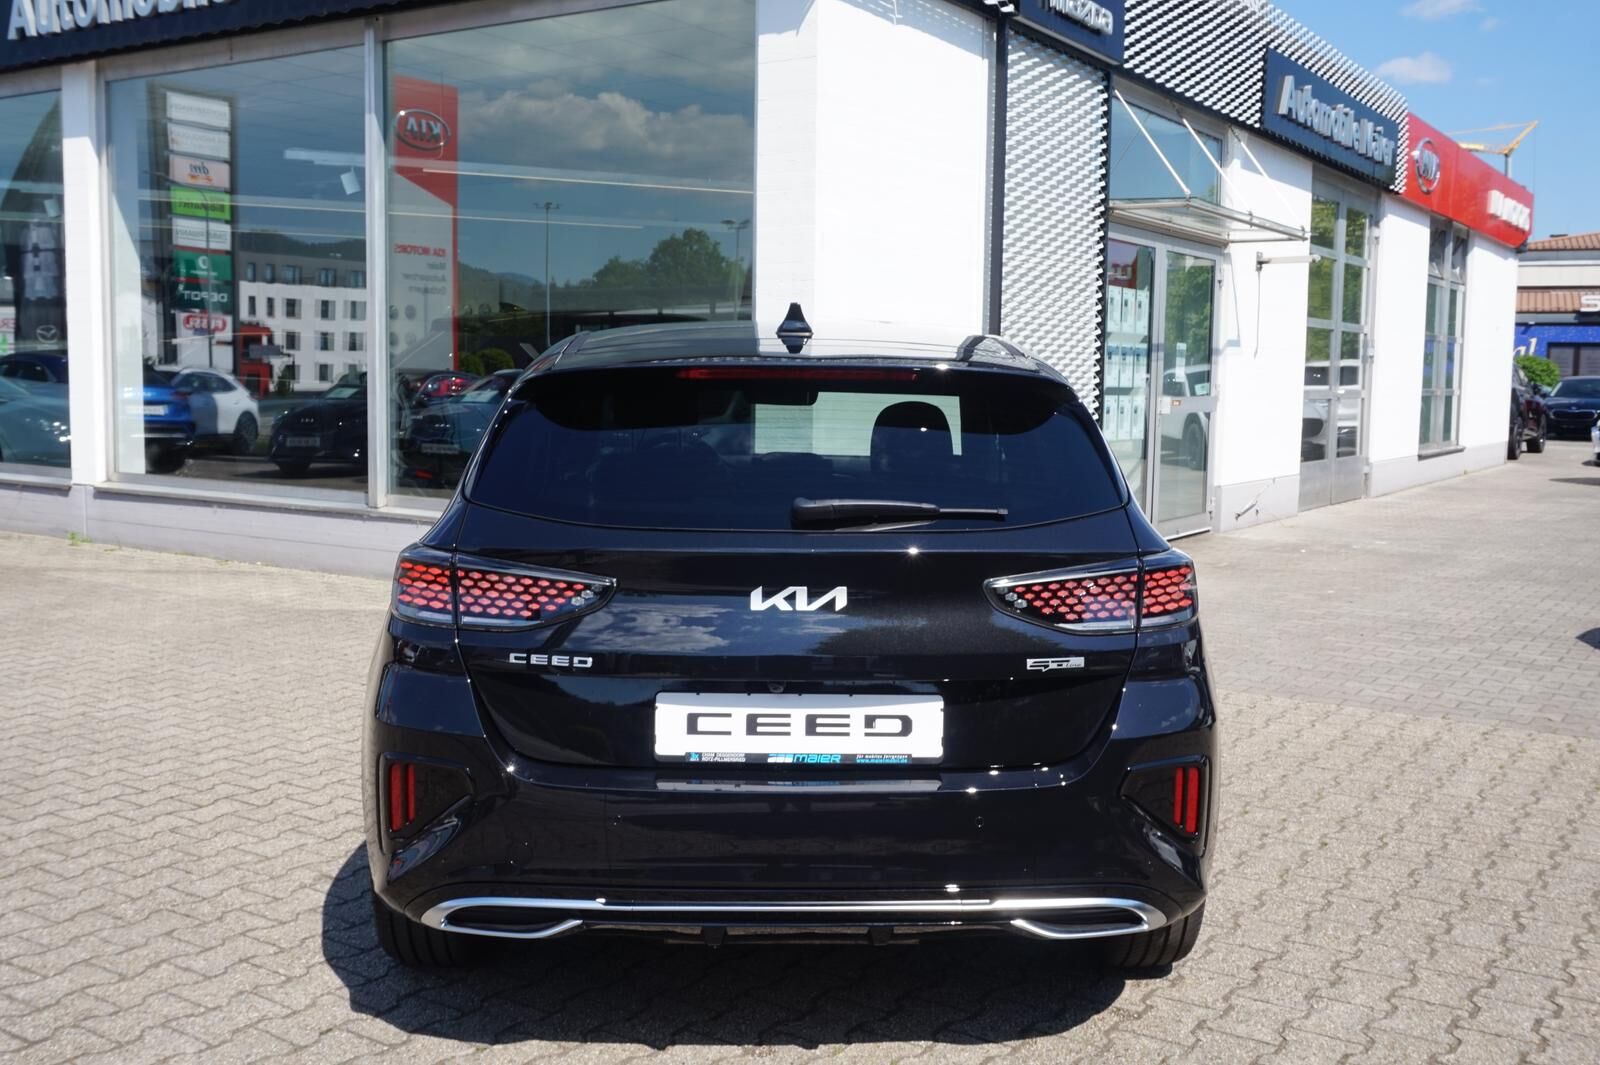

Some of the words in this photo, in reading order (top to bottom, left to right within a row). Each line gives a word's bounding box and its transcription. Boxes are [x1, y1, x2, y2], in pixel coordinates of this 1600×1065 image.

[749, 585, 849, 612] KIA
[508, 652, 594, 669] CEED
[686, 712, 913, 738] CEED
